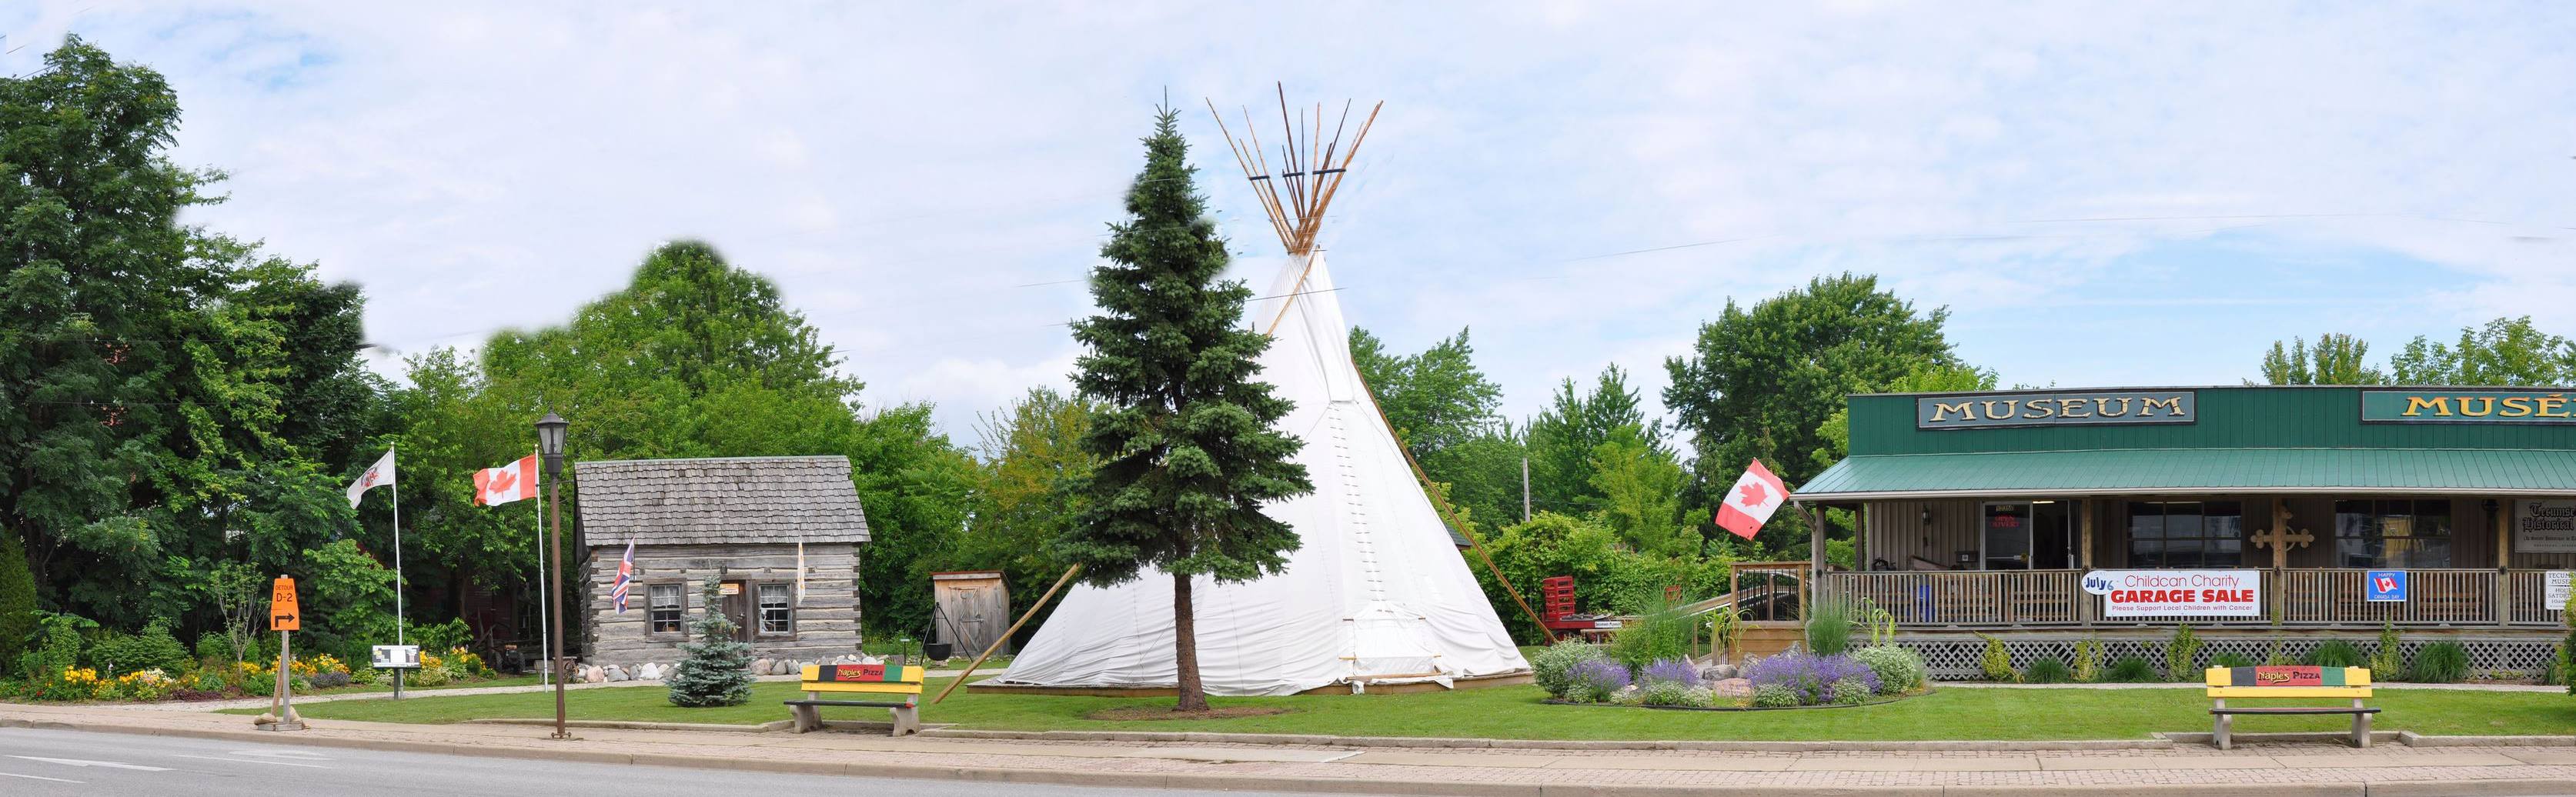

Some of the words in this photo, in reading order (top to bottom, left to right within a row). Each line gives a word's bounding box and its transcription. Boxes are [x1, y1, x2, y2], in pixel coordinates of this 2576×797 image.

[1929, 395, 2186, 422] MUSEUM
[2401, 393, 2576, 418] MUSÉ
[2085, 576, 2107, 591] July
[2107, 579, 2114, 591] 6
[2125, 575, 2187, 588] Childcan
[2191, 574, 2240, 589] Charity
[276, 592, 293, 602] D-2
[2111, 589, 2195, 603] GARAGE
[2202, 589, 2254, 603] SALE
[837, 669, 862, 679] Naples
[2257, 671, 2290, 684] Naples
